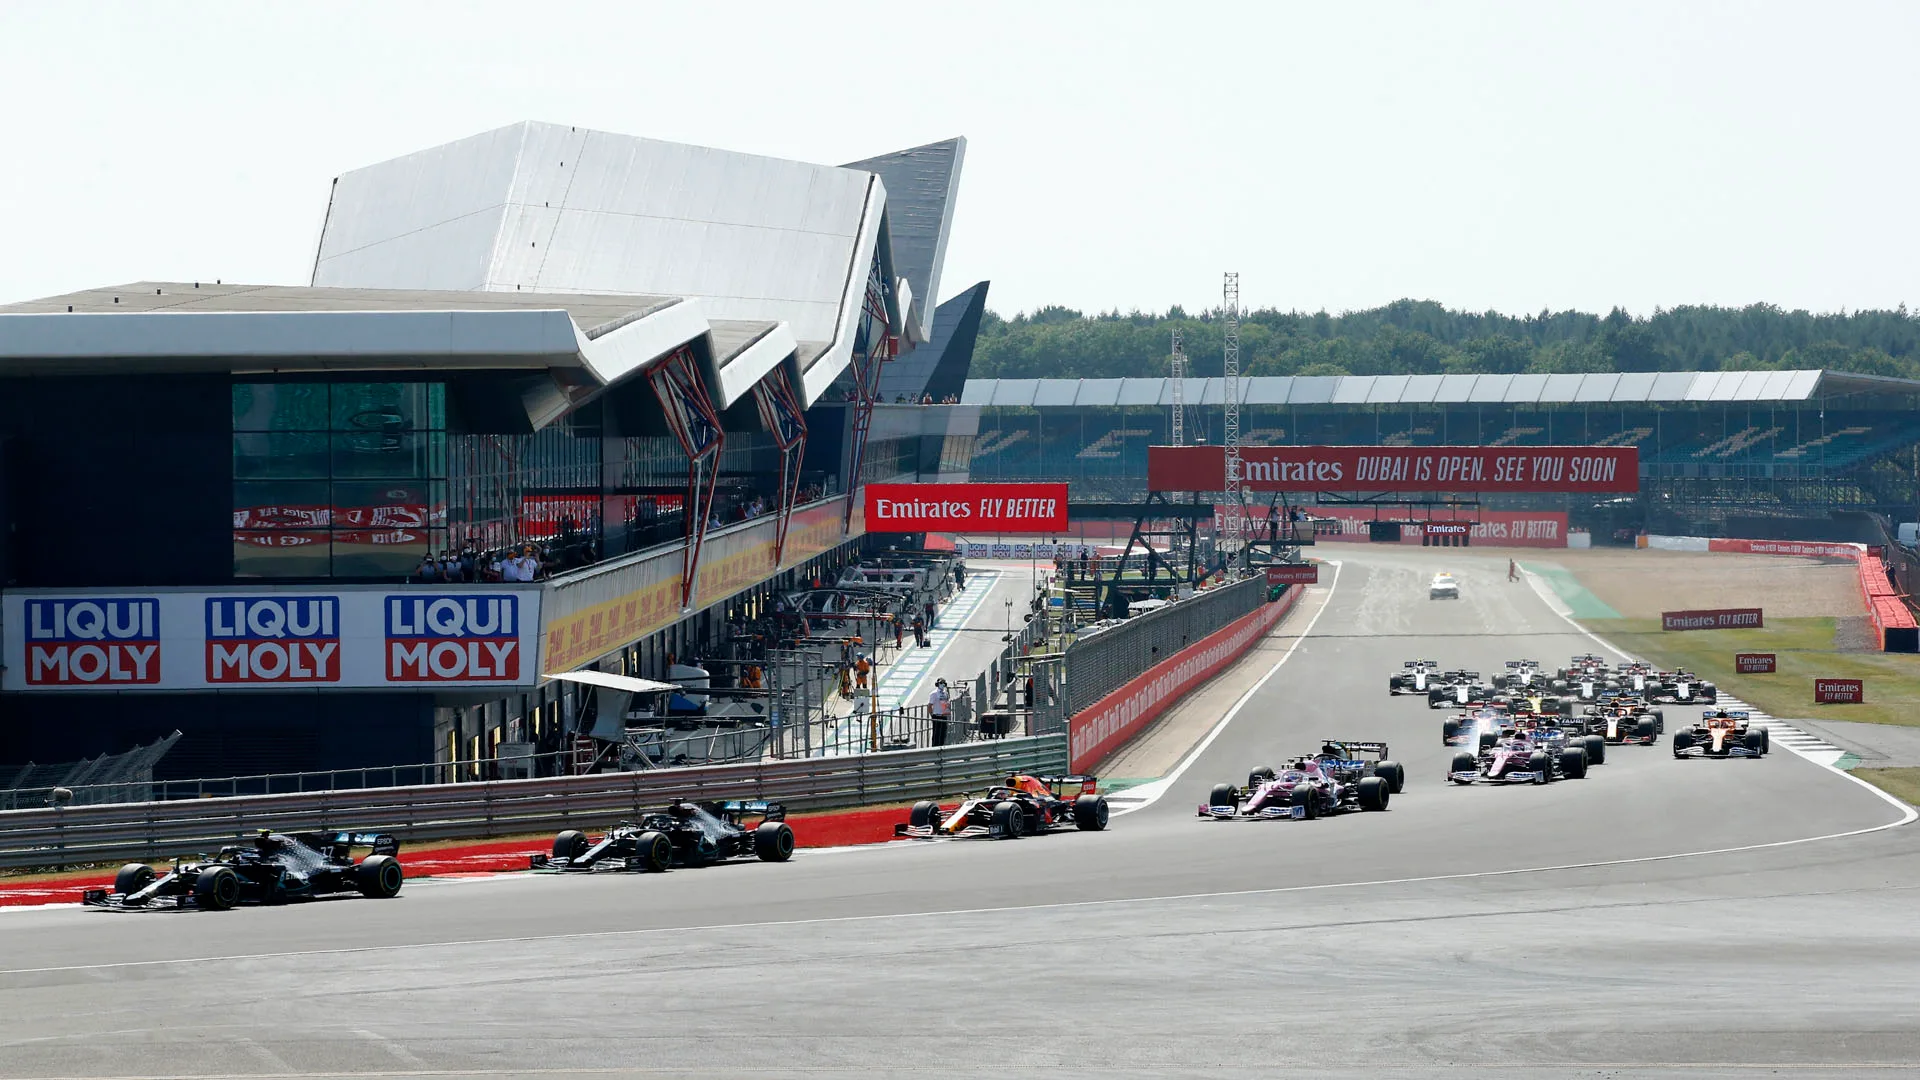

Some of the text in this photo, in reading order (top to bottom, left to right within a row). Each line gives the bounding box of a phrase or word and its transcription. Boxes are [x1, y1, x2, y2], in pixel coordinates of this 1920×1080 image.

[1356, 456, 1409, 481] DUBAI
[1414, 456, 1432, 481] IS
[1437, 456, 1487, 481] OPEN.
[1494, 456, 1527, 481] SEE
[1532, 456, 1564, 481] YOU
[1569, 457, 1617, 481] SOON
[876, 498, 1056, 519] Emirates FLY BETTER
[1426, 524, 1466, 533] Emirates
[1511, 520, 1526, 538] FLY
[1527, 520, 1558, 539] BETTER
[32, 602, 153, 641] LIQUI
[212, 600, 333, 639] LIQUI
[391, 598, 512, 637] LIQUI
[1666, 613, 1758, 627] Emirates FLY BETTER
[32, 645, 158, 682] MOLY
[212, 642, 338, 680] MOLY
[392, 641, 517, 678] MOLY
[1739, 656, 1773, 664] Emirates
[1819, 683, 1859, 692] Emirates
